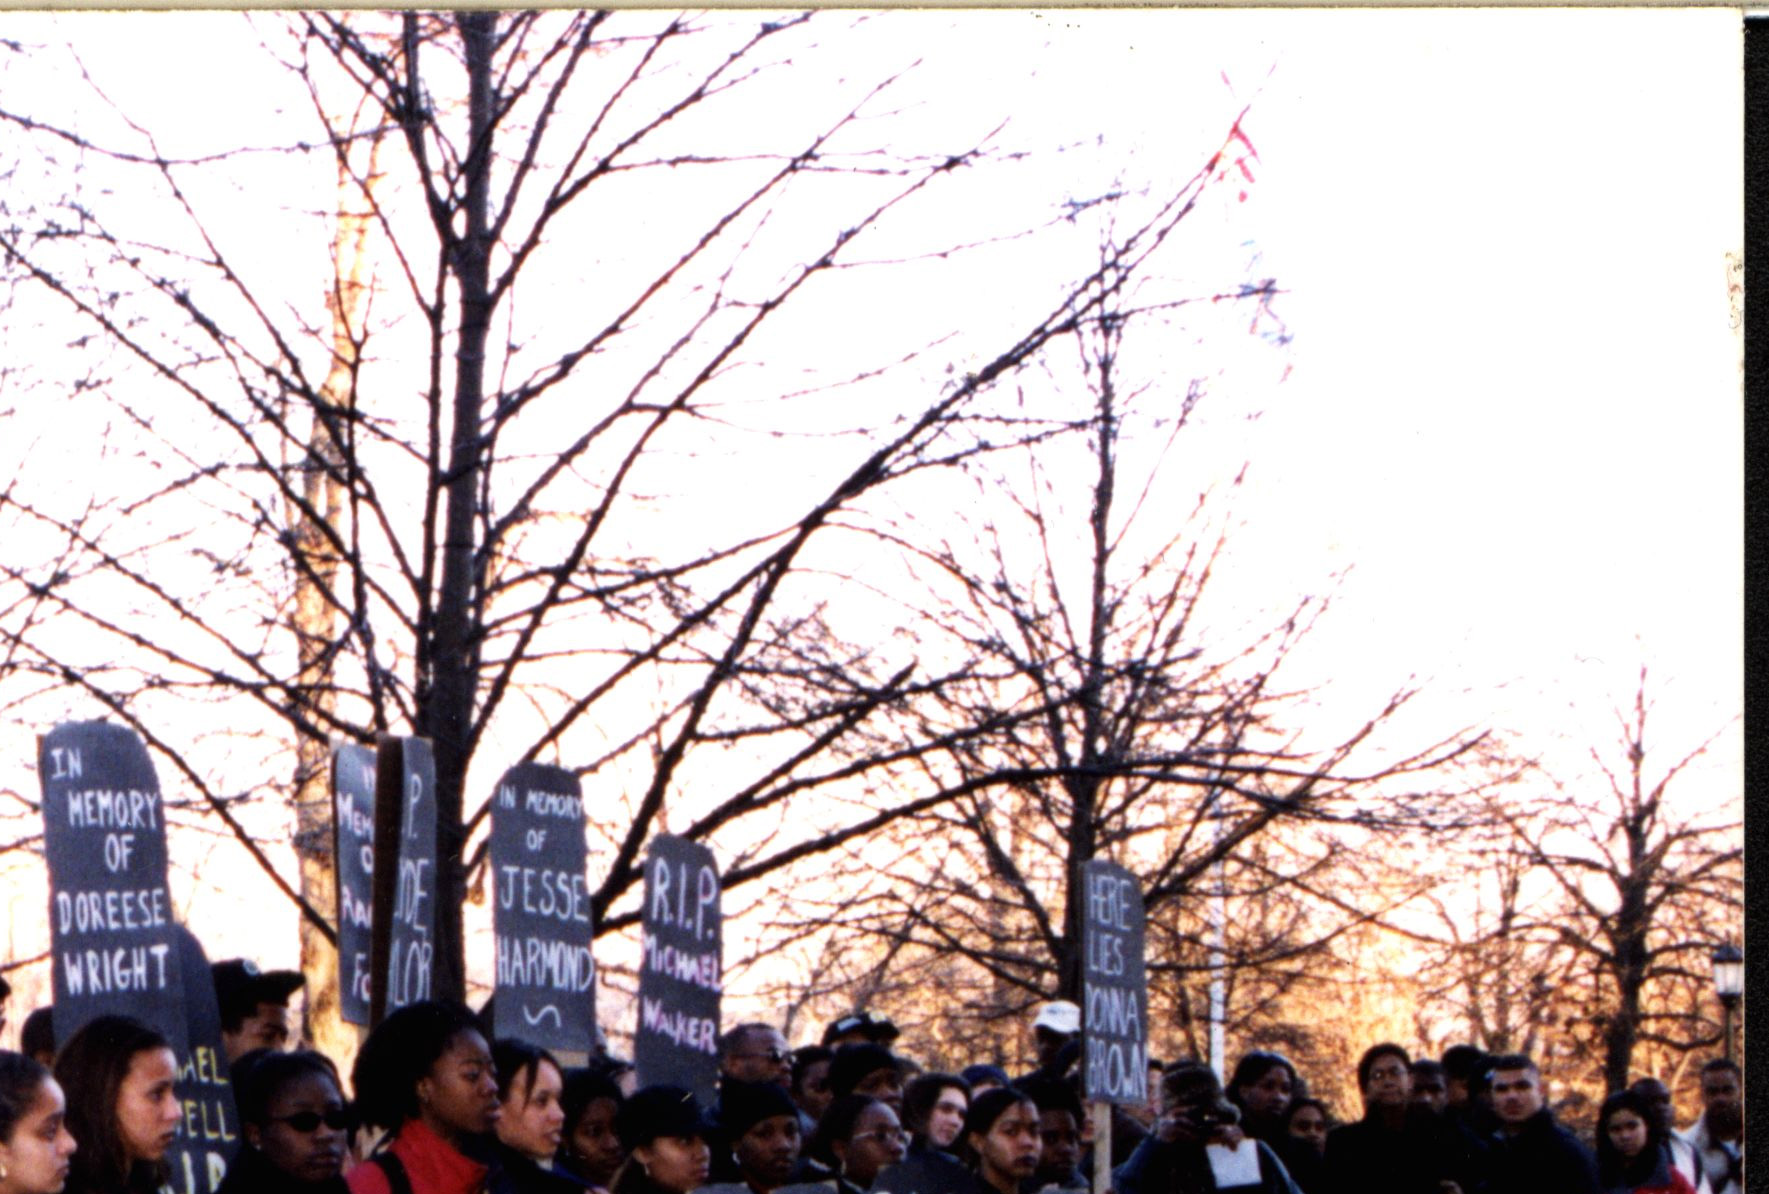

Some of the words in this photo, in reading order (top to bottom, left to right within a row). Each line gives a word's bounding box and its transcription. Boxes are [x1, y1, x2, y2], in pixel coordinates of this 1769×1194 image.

[50, 748, 83, 780] IN
[68, 789, 159, 830] MEMORY
[500, 785, 515, 807] IN
[526, 789, 583, 820] MEMORY
[104, 834, 136, 873] OF
[526, 829, 547, 852] OF
[57, 888, 166, 936] DOREESE
[502, 865, 588, 922] JESSE
[652, 856, 716, 940] R.I.P.
[1090, 873, 1131, 931] HERE
[63, 943, 170, 996] WRIGHT
[497, 935, 595, 992] HARMOND
[642, 933, 722, 991] MICHAEL
[1089, 930, 1123, 976] LIES
[643, 999, 716, 1054] WALKER
[1089, 1036, 1147, 1100] BROWN
